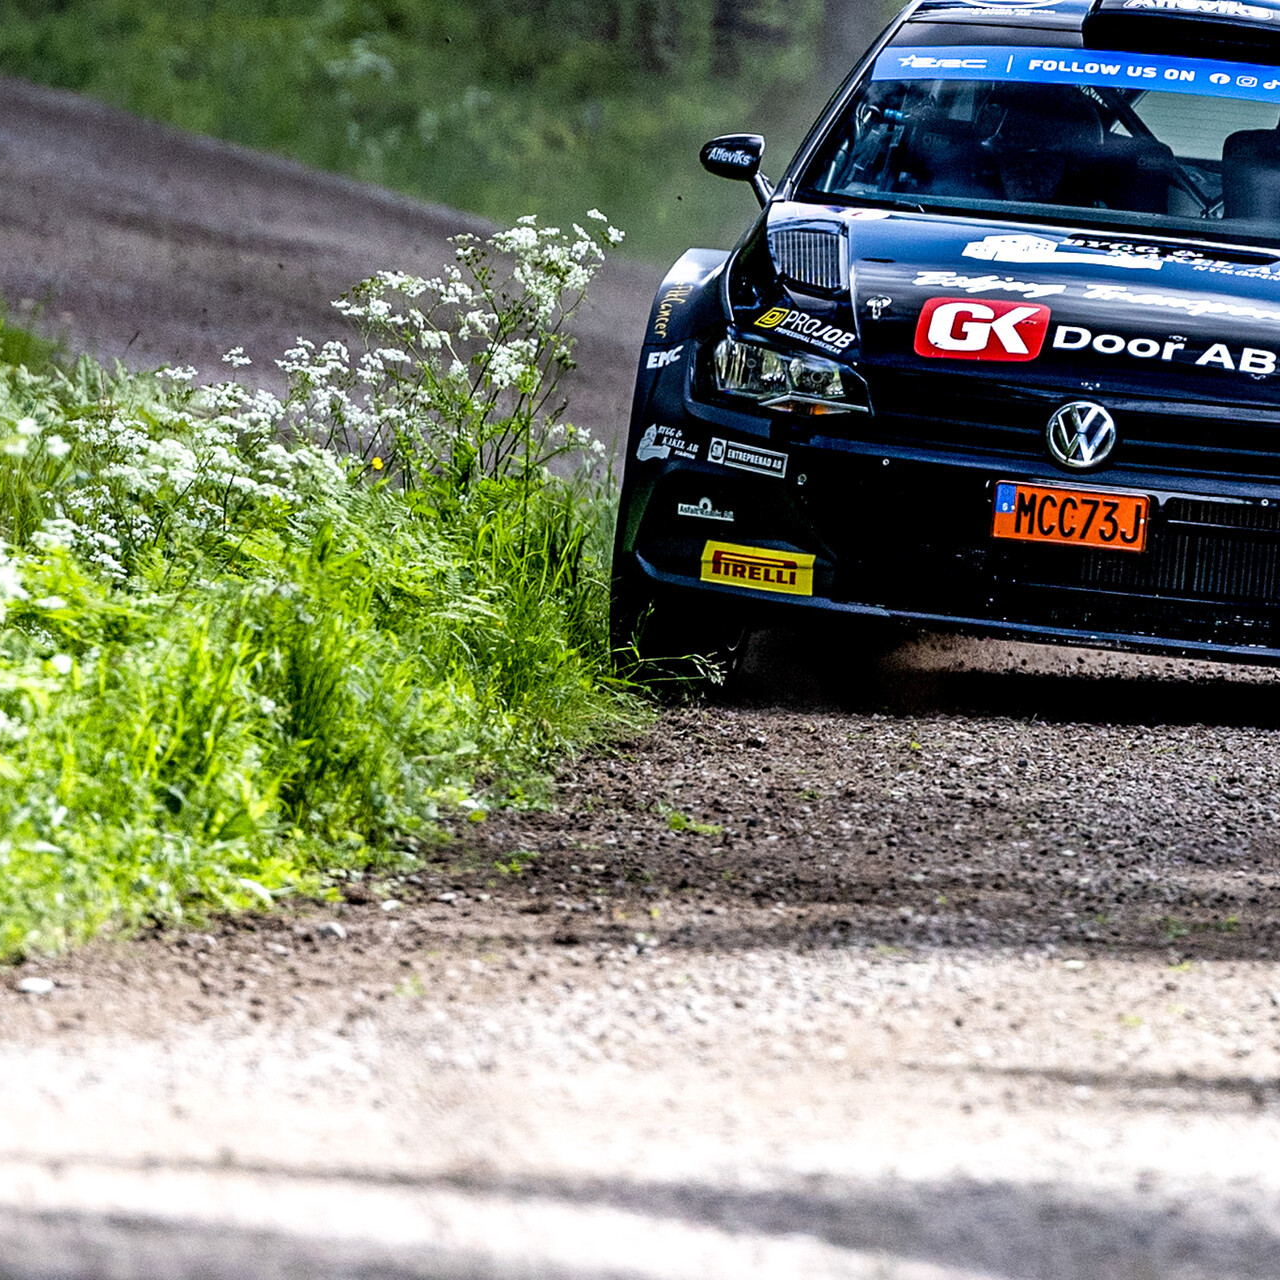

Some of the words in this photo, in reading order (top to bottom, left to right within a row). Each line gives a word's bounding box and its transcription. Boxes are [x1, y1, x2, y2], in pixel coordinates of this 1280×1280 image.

[1029, 59, 1121, 75] FOLLOW
[1127, 65, 1157, 78] US
[1164, 69, 1195, 81] ON
[707, 147, 752, 167] Atteviks
[780, 310, 856, 348] PROJOB
[927, 302, 1041, 355] GK
[1052, 325, 1185, 361] Door
[1195, 343, 1277, 375] AB
[646, 345, 684, 369] EMC
[727, 449, 772, 467] ENTREPRENAD
[772, 459, 783, 470] AB
[1014, 491, 1142, 544] MCC73J
[711, 549, 798, 586] PIRELLI
